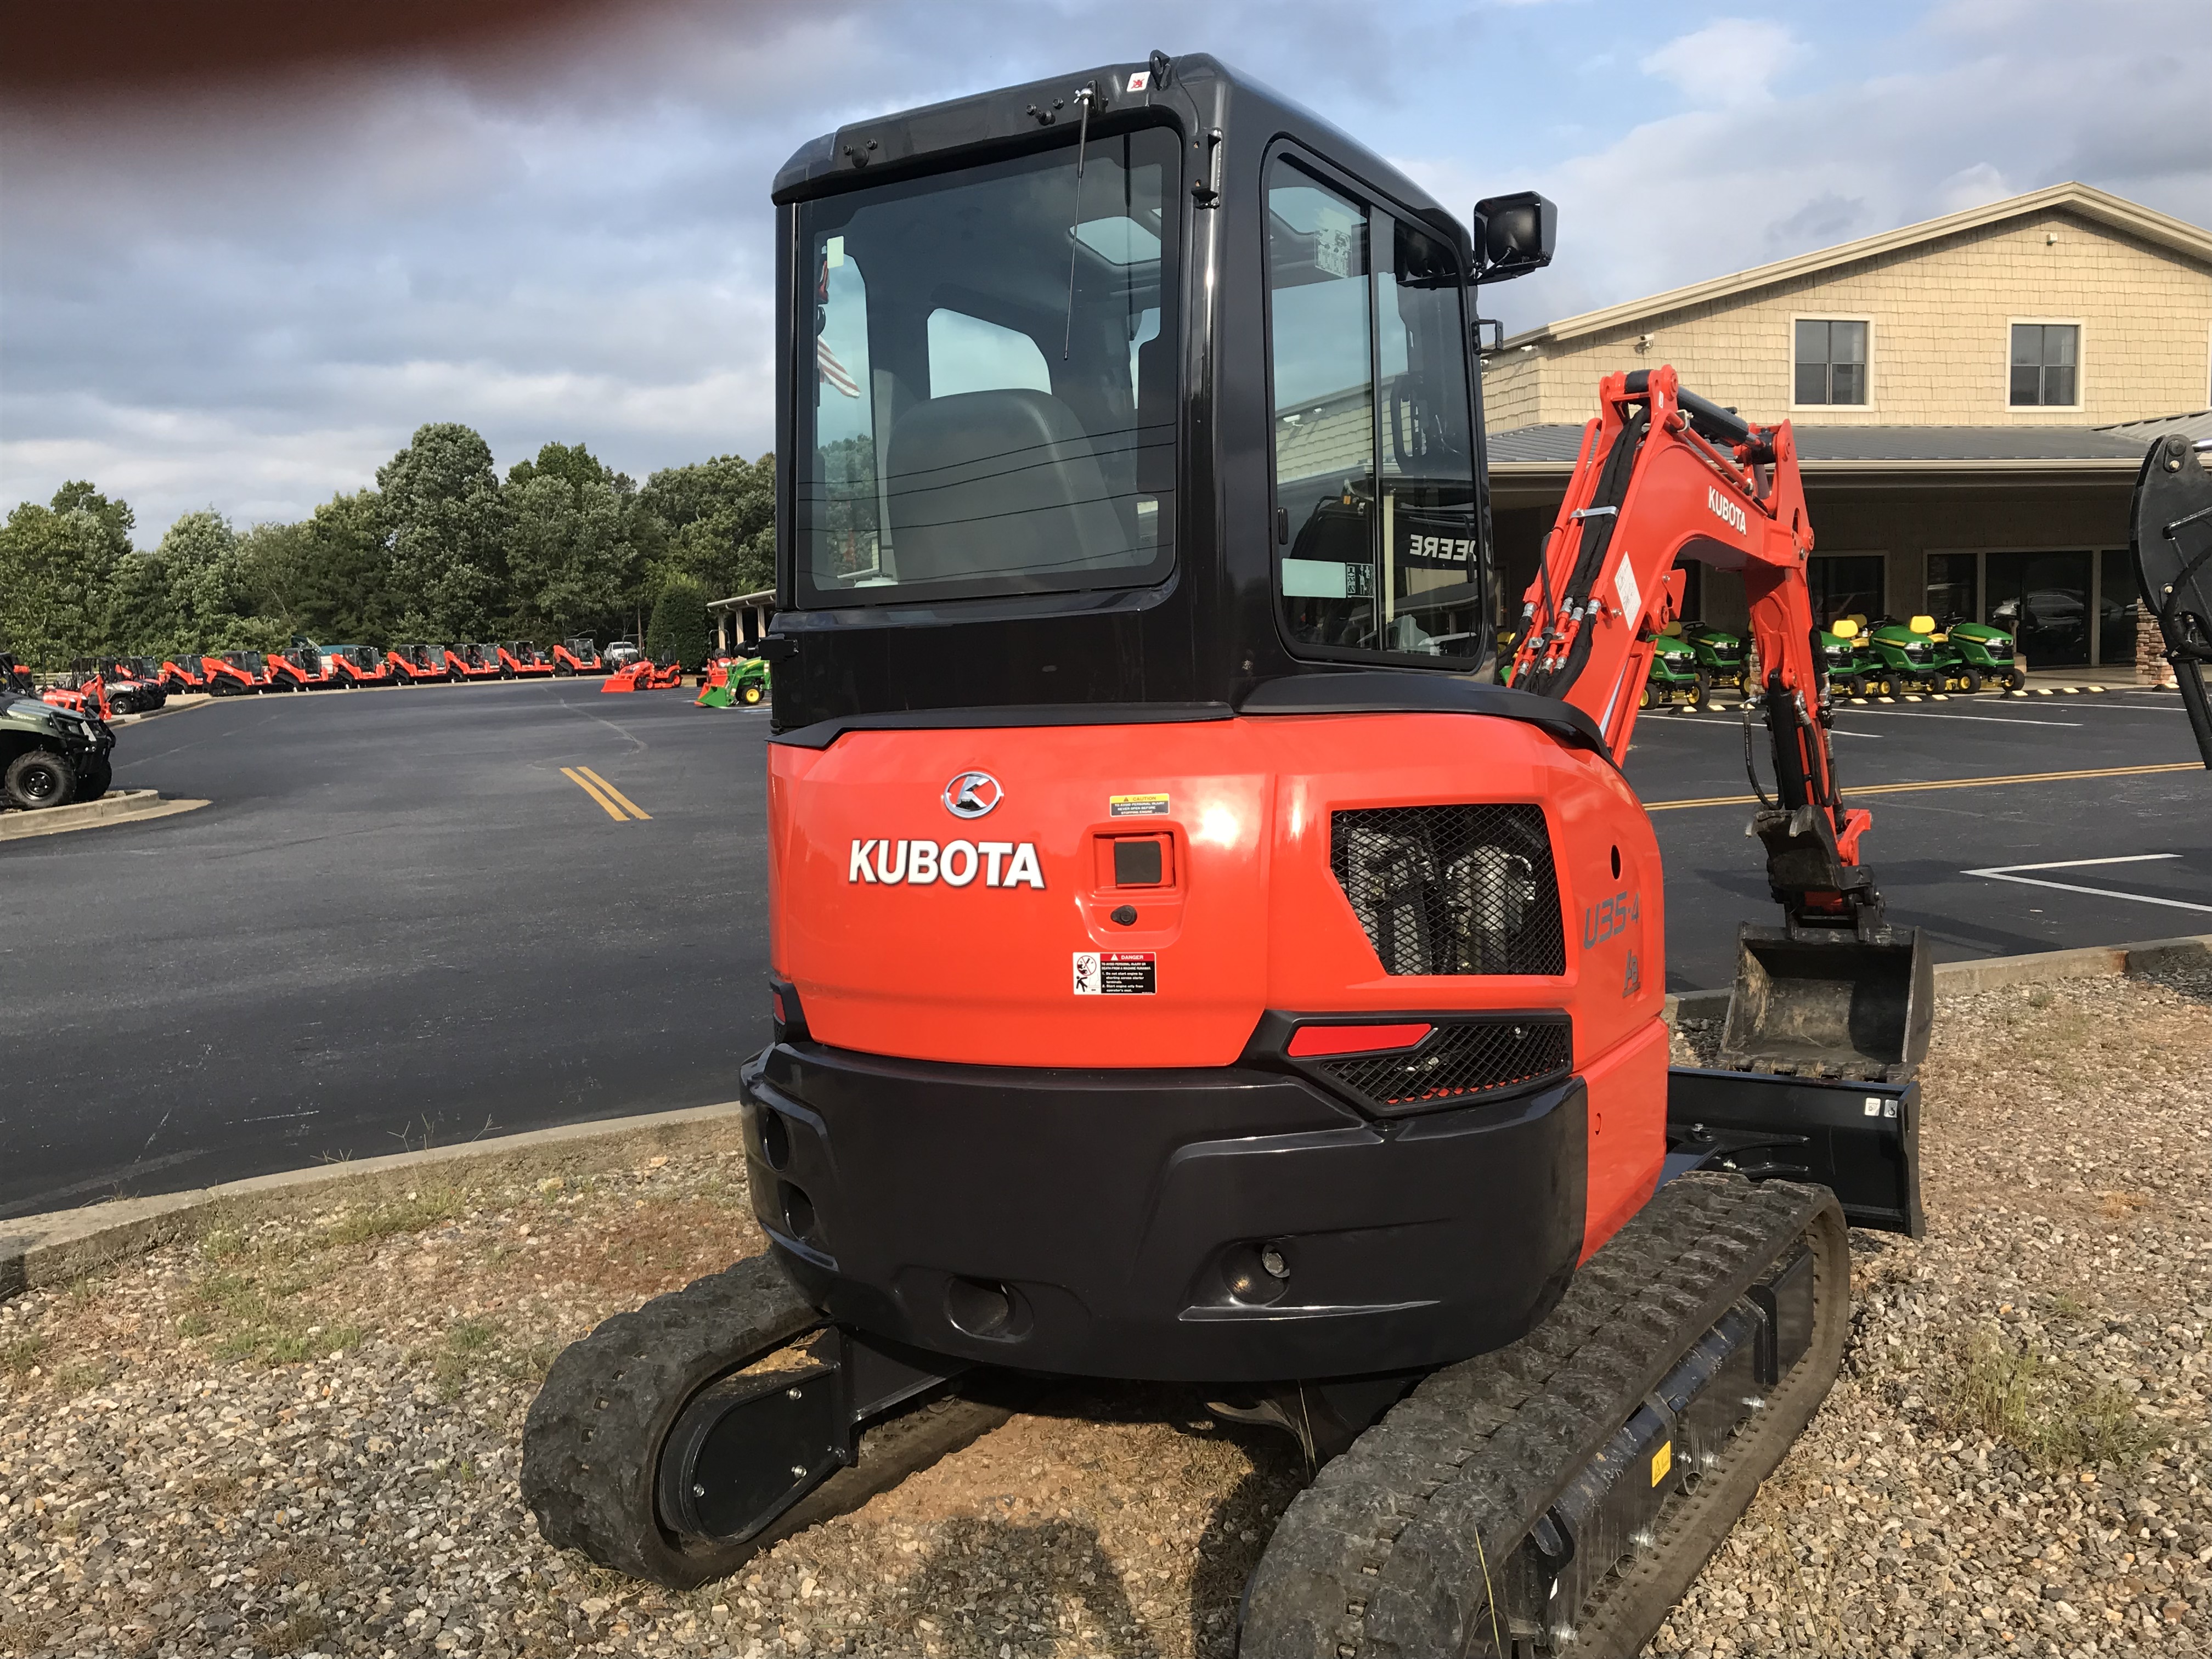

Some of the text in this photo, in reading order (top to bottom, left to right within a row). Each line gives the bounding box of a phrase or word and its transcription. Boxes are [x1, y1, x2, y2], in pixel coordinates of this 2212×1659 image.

[1708, 485, 1746, 535] KUBOTA
[849, 839, 1045, 889] KUBOTA
[1583, 890, 1640, 950] U35-4
